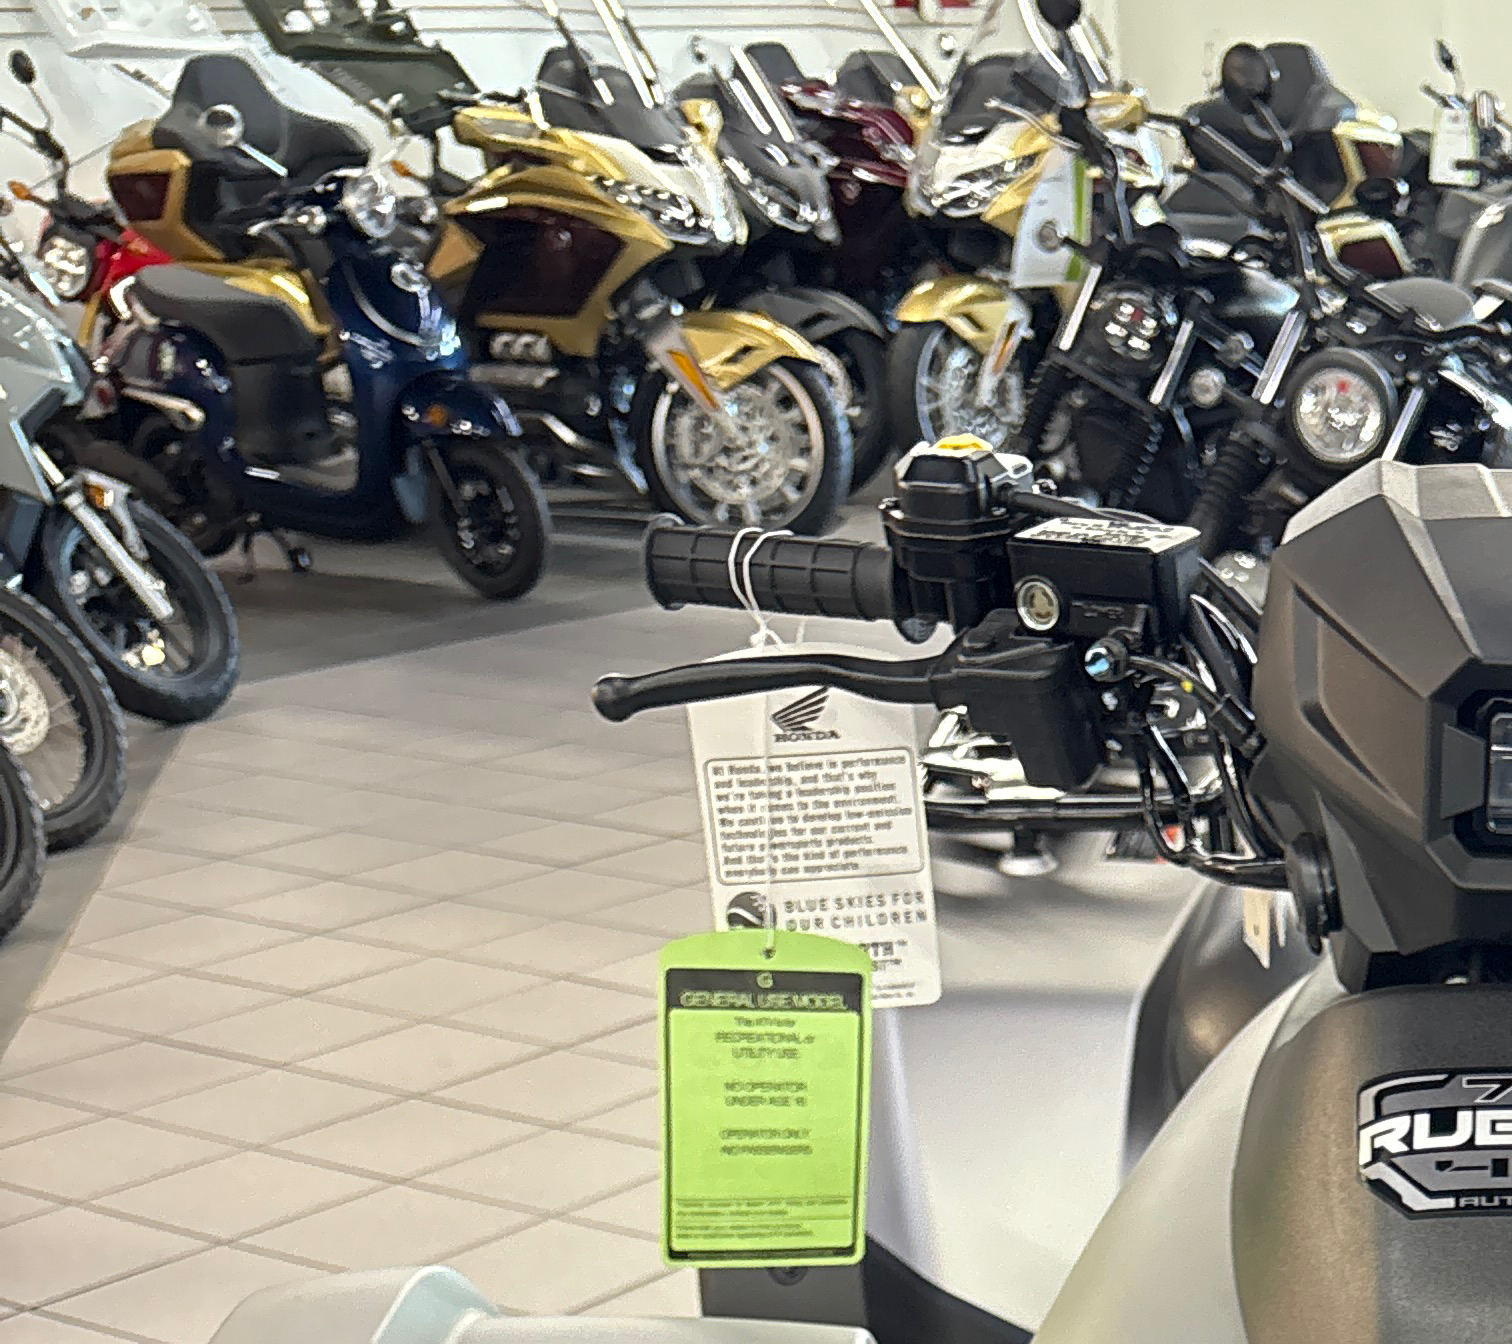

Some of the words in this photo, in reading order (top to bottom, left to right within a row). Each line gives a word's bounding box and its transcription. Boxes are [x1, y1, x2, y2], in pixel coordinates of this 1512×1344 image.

[772, 730, 841, 742] HONDA
[784, 897, 828, 913] BLUE
[834, 894, 887, 911] SKIES
[892, 891, 924, 907] FOR
[785, 915, 824, 932] OUR
[830, 909, 927, 929] CHILDREN
